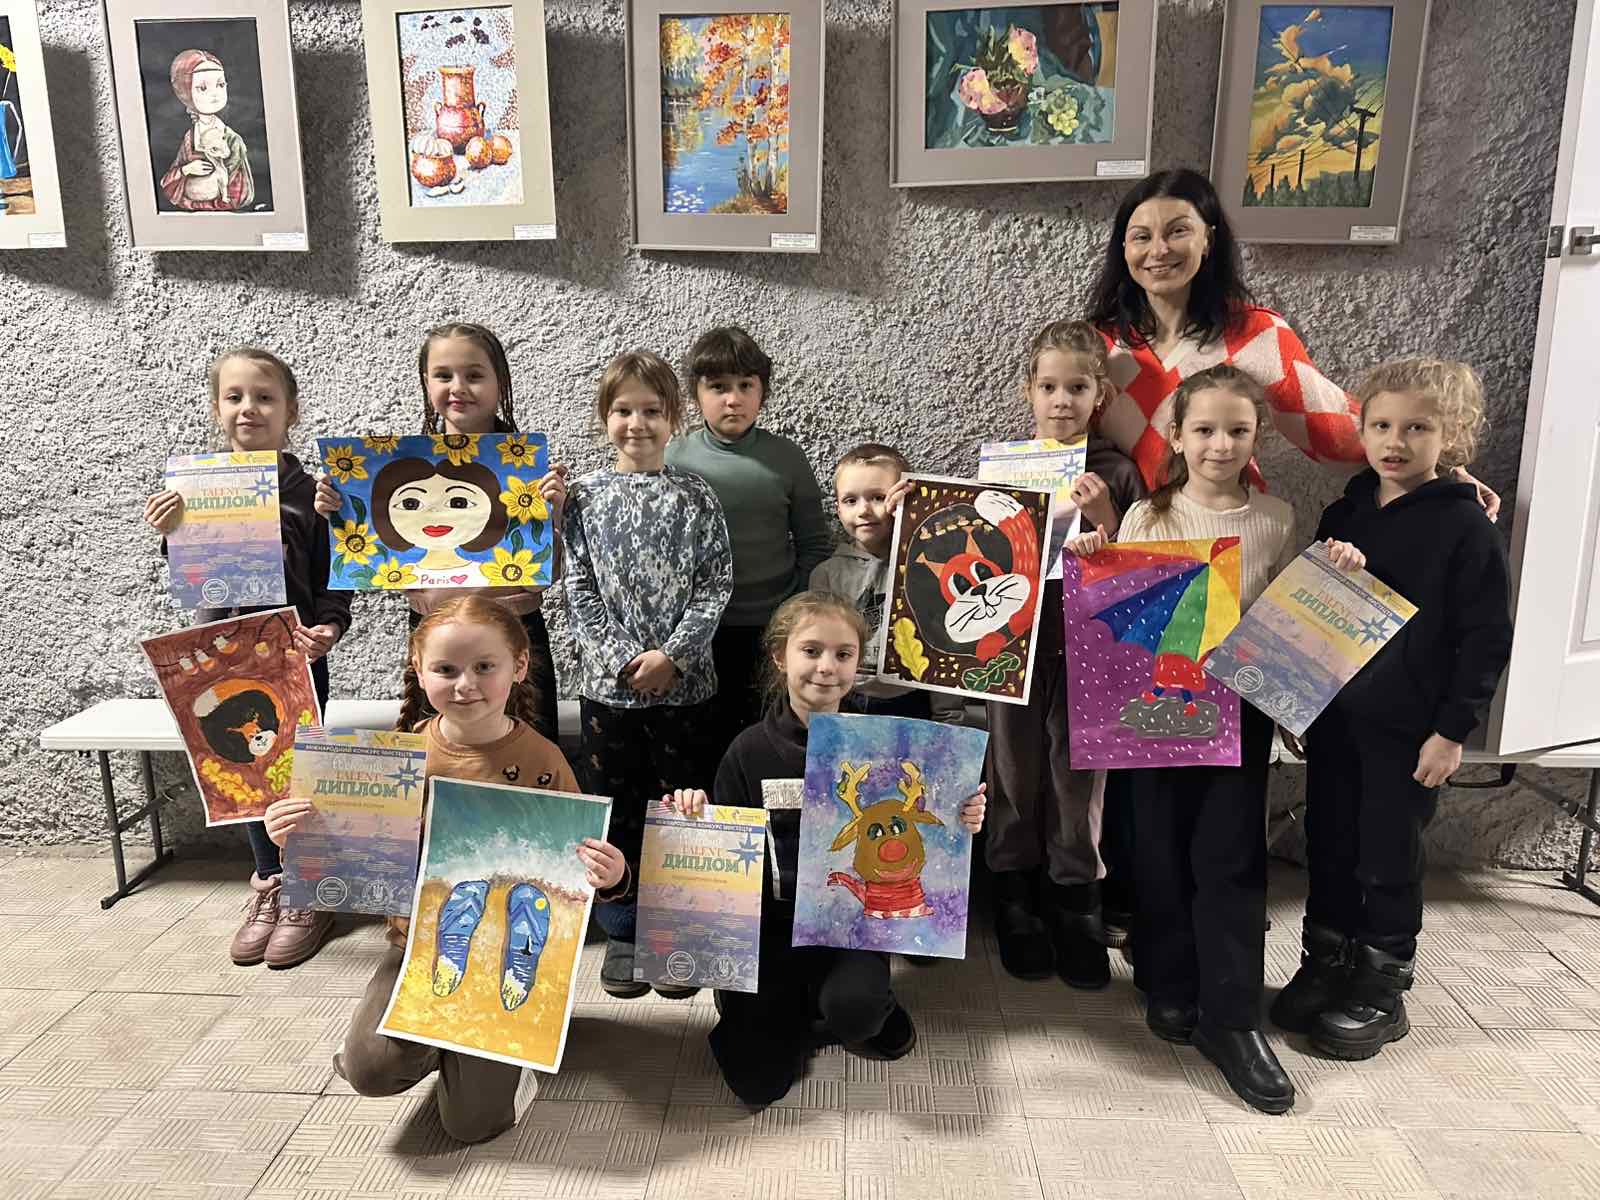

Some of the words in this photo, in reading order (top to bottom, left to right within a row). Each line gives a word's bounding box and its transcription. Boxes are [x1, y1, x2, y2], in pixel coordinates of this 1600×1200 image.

[201, 487, 240, 496] TALENT
[185, 495, 257, 511] ДИПЛОМ
[420, 574, 450, 585] Paris
[1289, 587, 1359, 640] ДИПЛОМ
[335, 770, 384, 781] TALENT
[313, 779, 398, 797] ДИПЛОМ
[662, 853, 739, 872] ДИПЛОМ
